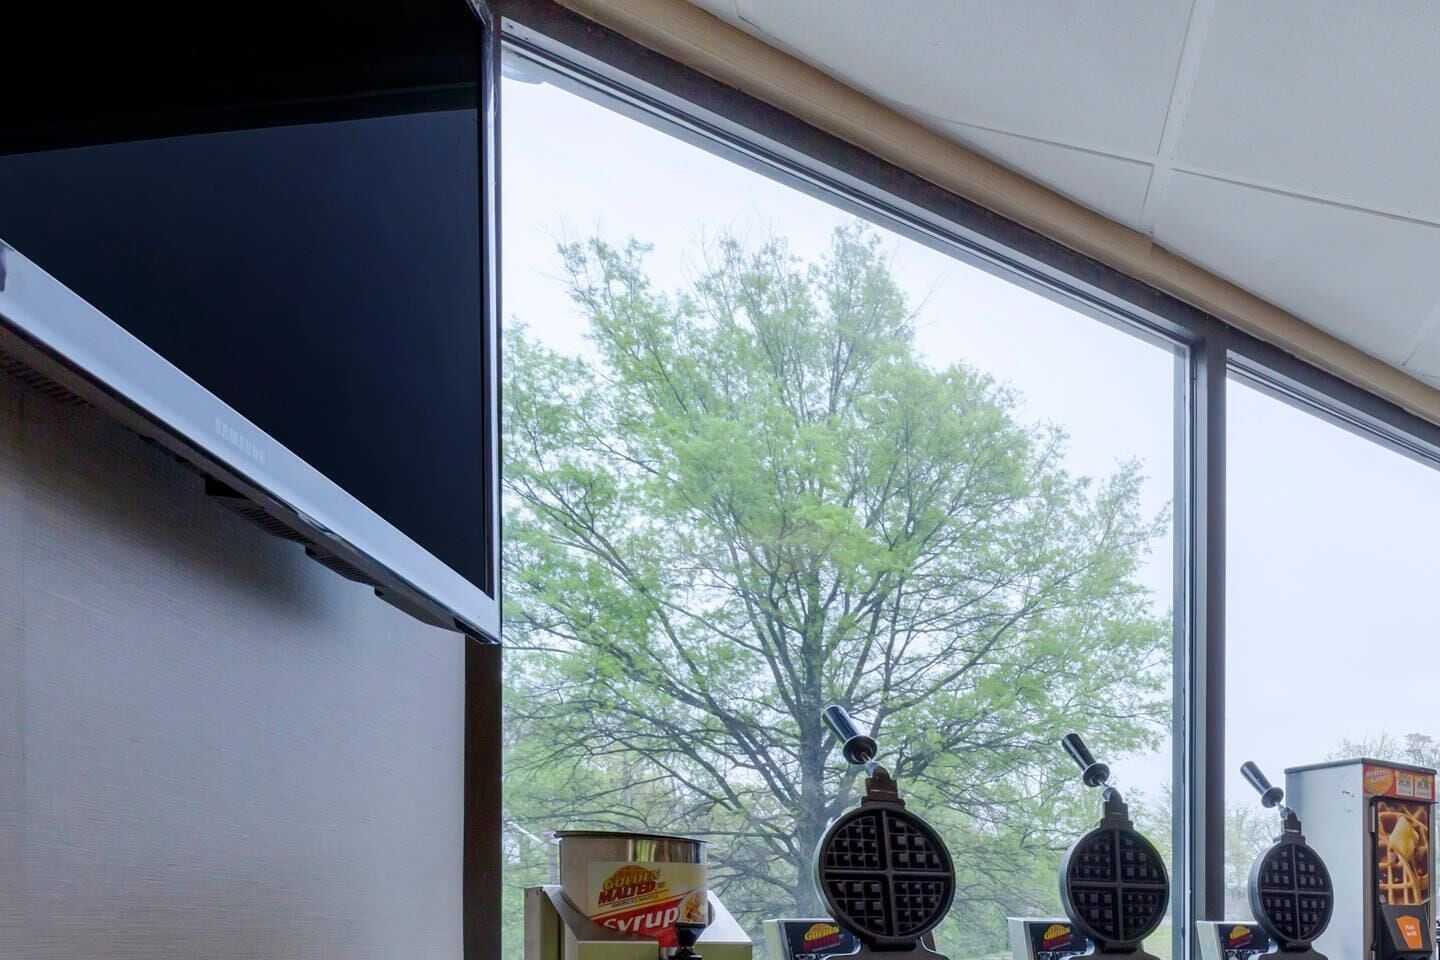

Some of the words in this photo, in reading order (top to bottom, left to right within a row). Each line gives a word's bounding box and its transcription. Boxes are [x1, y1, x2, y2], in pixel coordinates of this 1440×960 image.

[215, 416, 267, 467] SAMSUNG
[598, 880, 656, 905] MALTED
[603, 869, 661, 891] GOLDEN
